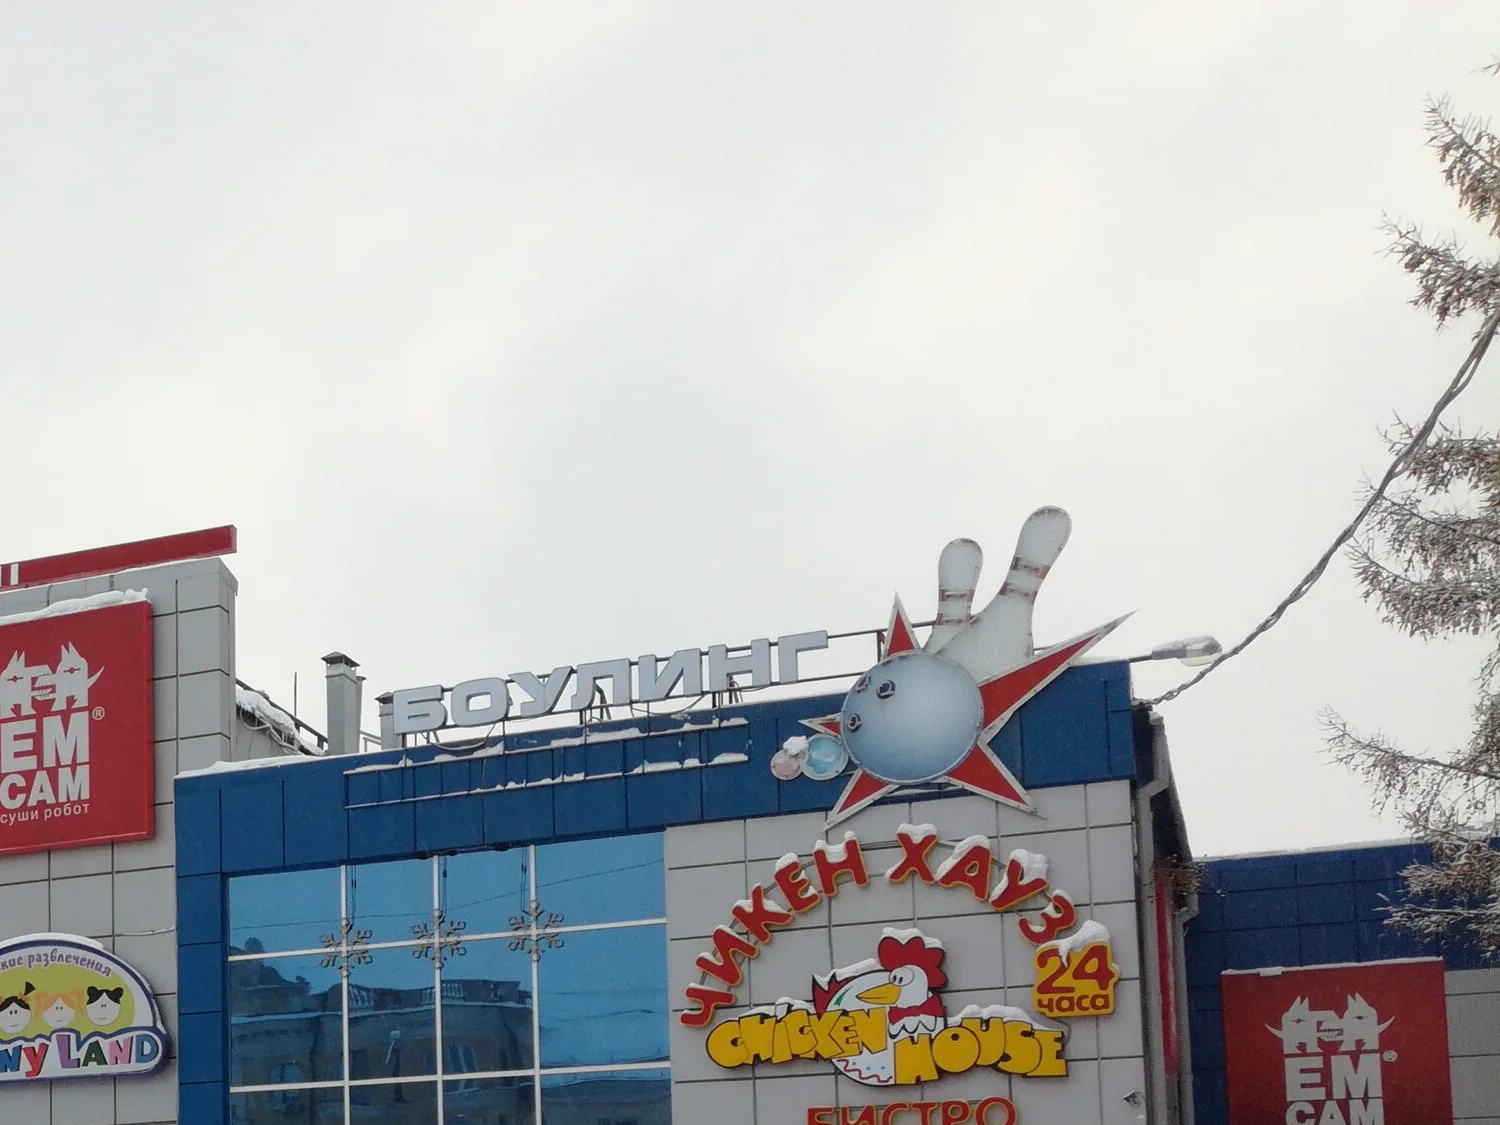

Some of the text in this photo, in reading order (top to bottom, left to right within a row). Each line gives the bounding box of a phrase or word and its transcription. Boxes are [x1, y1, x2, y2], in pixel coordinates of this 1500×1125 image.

[394, 630, 828, 734] БОУЛИНГ
[0, 710, 89, 774] ЕМ
[0, 764, 90, 810] САМ
[0, 803, 90, 826] суши робот
[680, 823, 1077, 1028] ЧИКЕН ХАУЗ
[27, 947, 112, 977] развлечения
[1037, 945, 1115, 995] 24
[1037, 993, 1110, 1013] часа
[56, 1033, 160, 1070] LAND
[706, 1003, 1069, 1086] CHICKEN HOUSE
[1284, 1052, 1383, 1102] ЕМ
